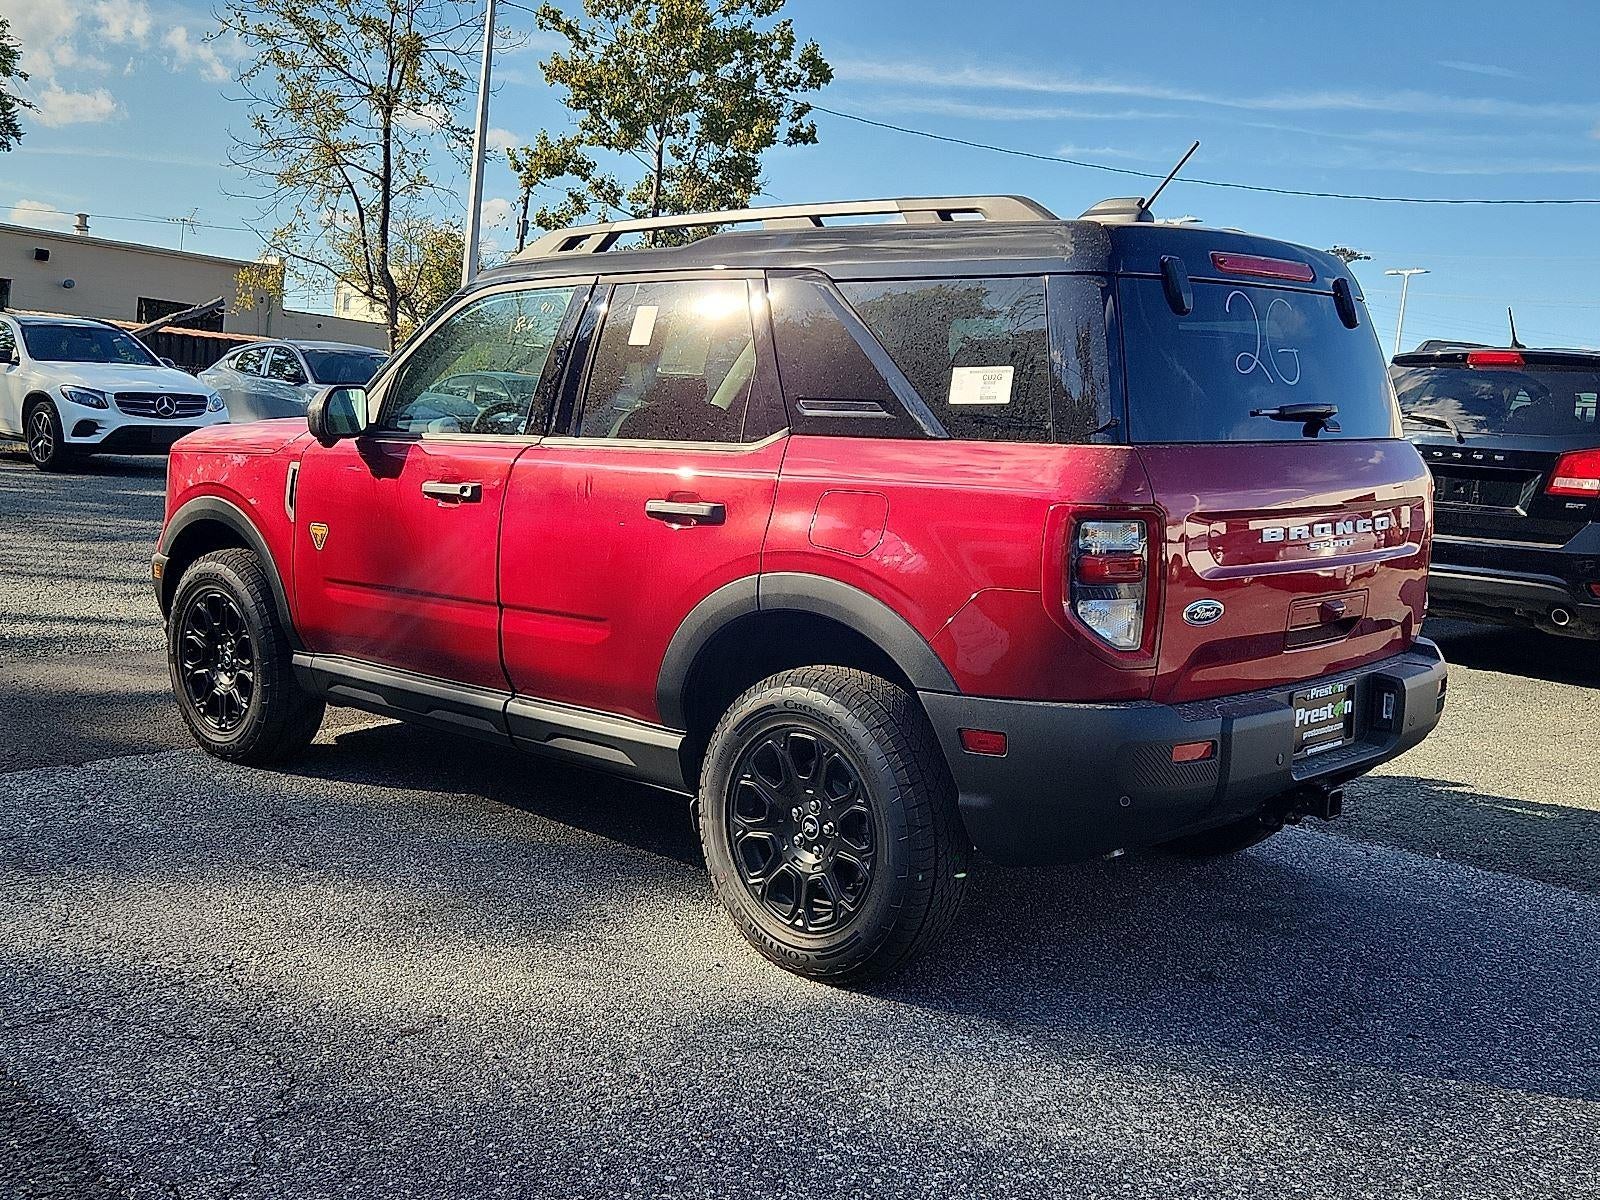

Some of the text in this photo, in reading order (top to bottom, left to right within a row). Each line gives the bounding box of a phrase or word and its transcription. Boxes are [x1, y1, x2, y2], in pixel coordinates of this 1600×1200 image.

[1225, 290, 1300, 385] 2G
[1261, 516, 1390, 543] BRONCO
[1308, 537, 1356, 551] SPORT
[1188, 604, 1218, 621] Ford
